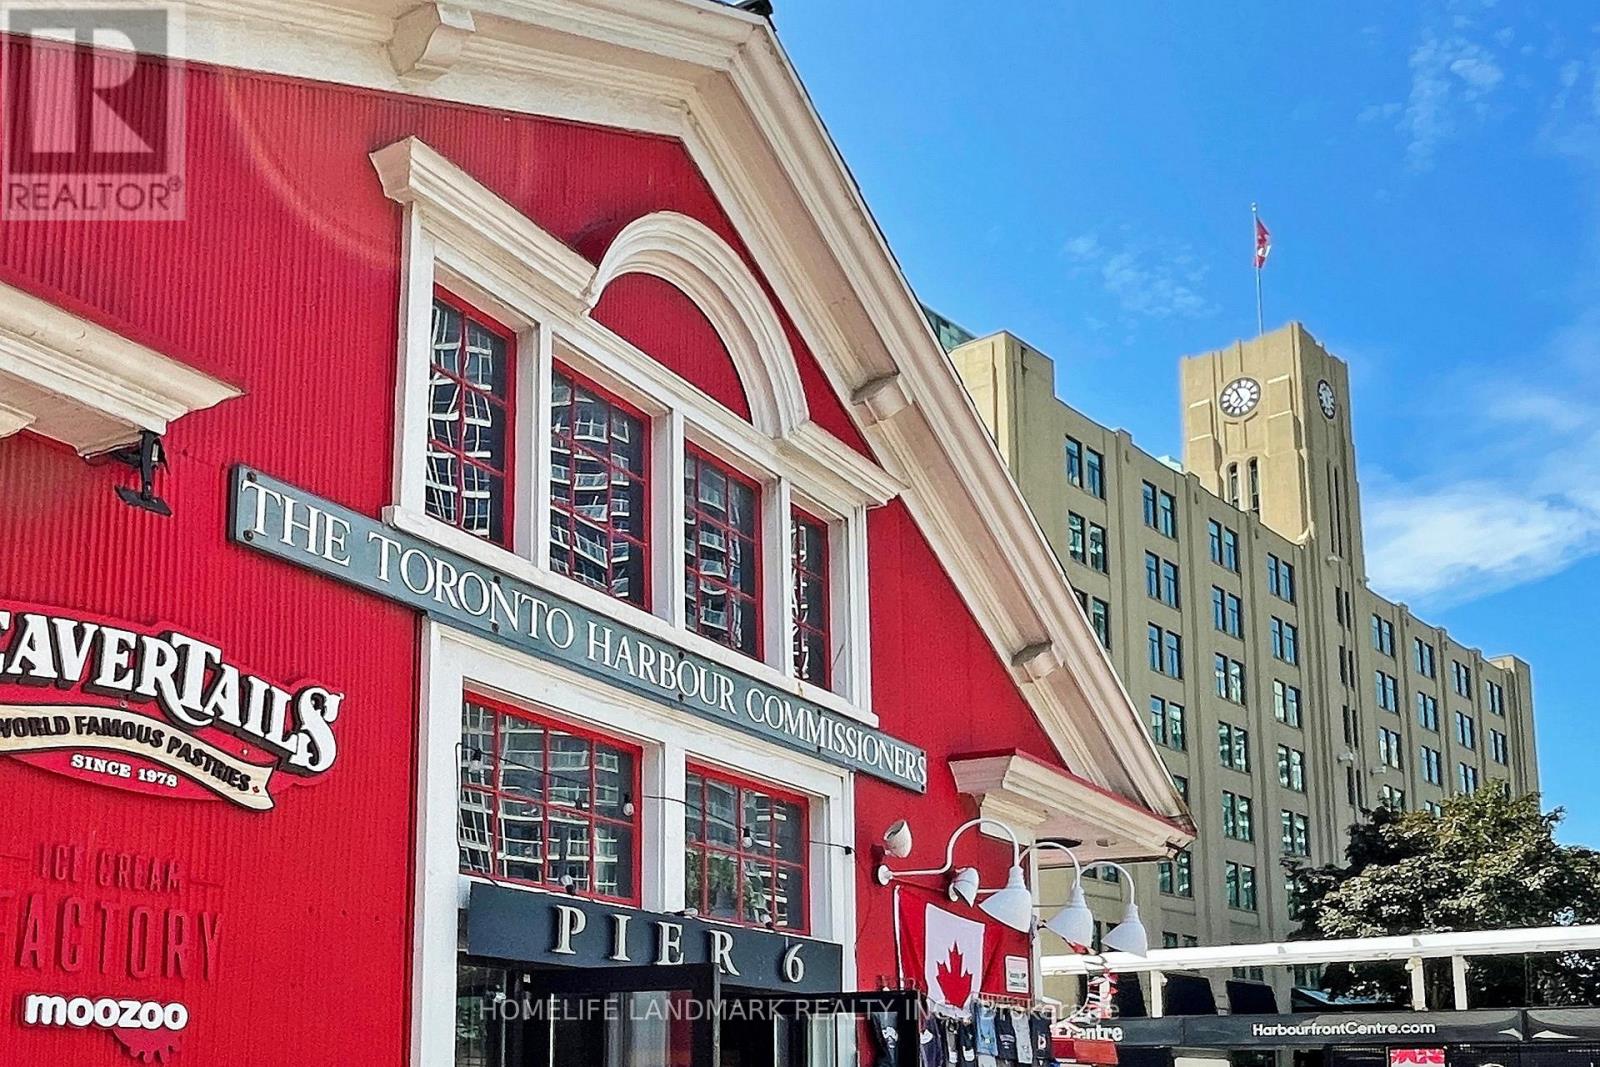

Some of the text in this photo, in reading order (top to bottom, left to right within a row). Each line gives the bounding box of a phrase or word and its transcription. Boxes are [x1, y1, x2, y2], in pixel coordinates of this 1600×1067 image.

[242, 480, 927, 785] THE TORONTO HARBOUR COMMISSIONERS
[0, 611, 343, 772] AVERTAILS
[70, 754, 178, 788] SINCE 1978
[74, 716, 164, 747] FAMOUS
[166, 736, 251, 792] PASTRIES
[40, 844, 182, 893] ICE CREAM
[552, 904, 805, 983] PIER 6
[25, 994, 188, 1030] moozoo
[1252, 1021, 1436, 1037] HarbourfrontCentre.com
